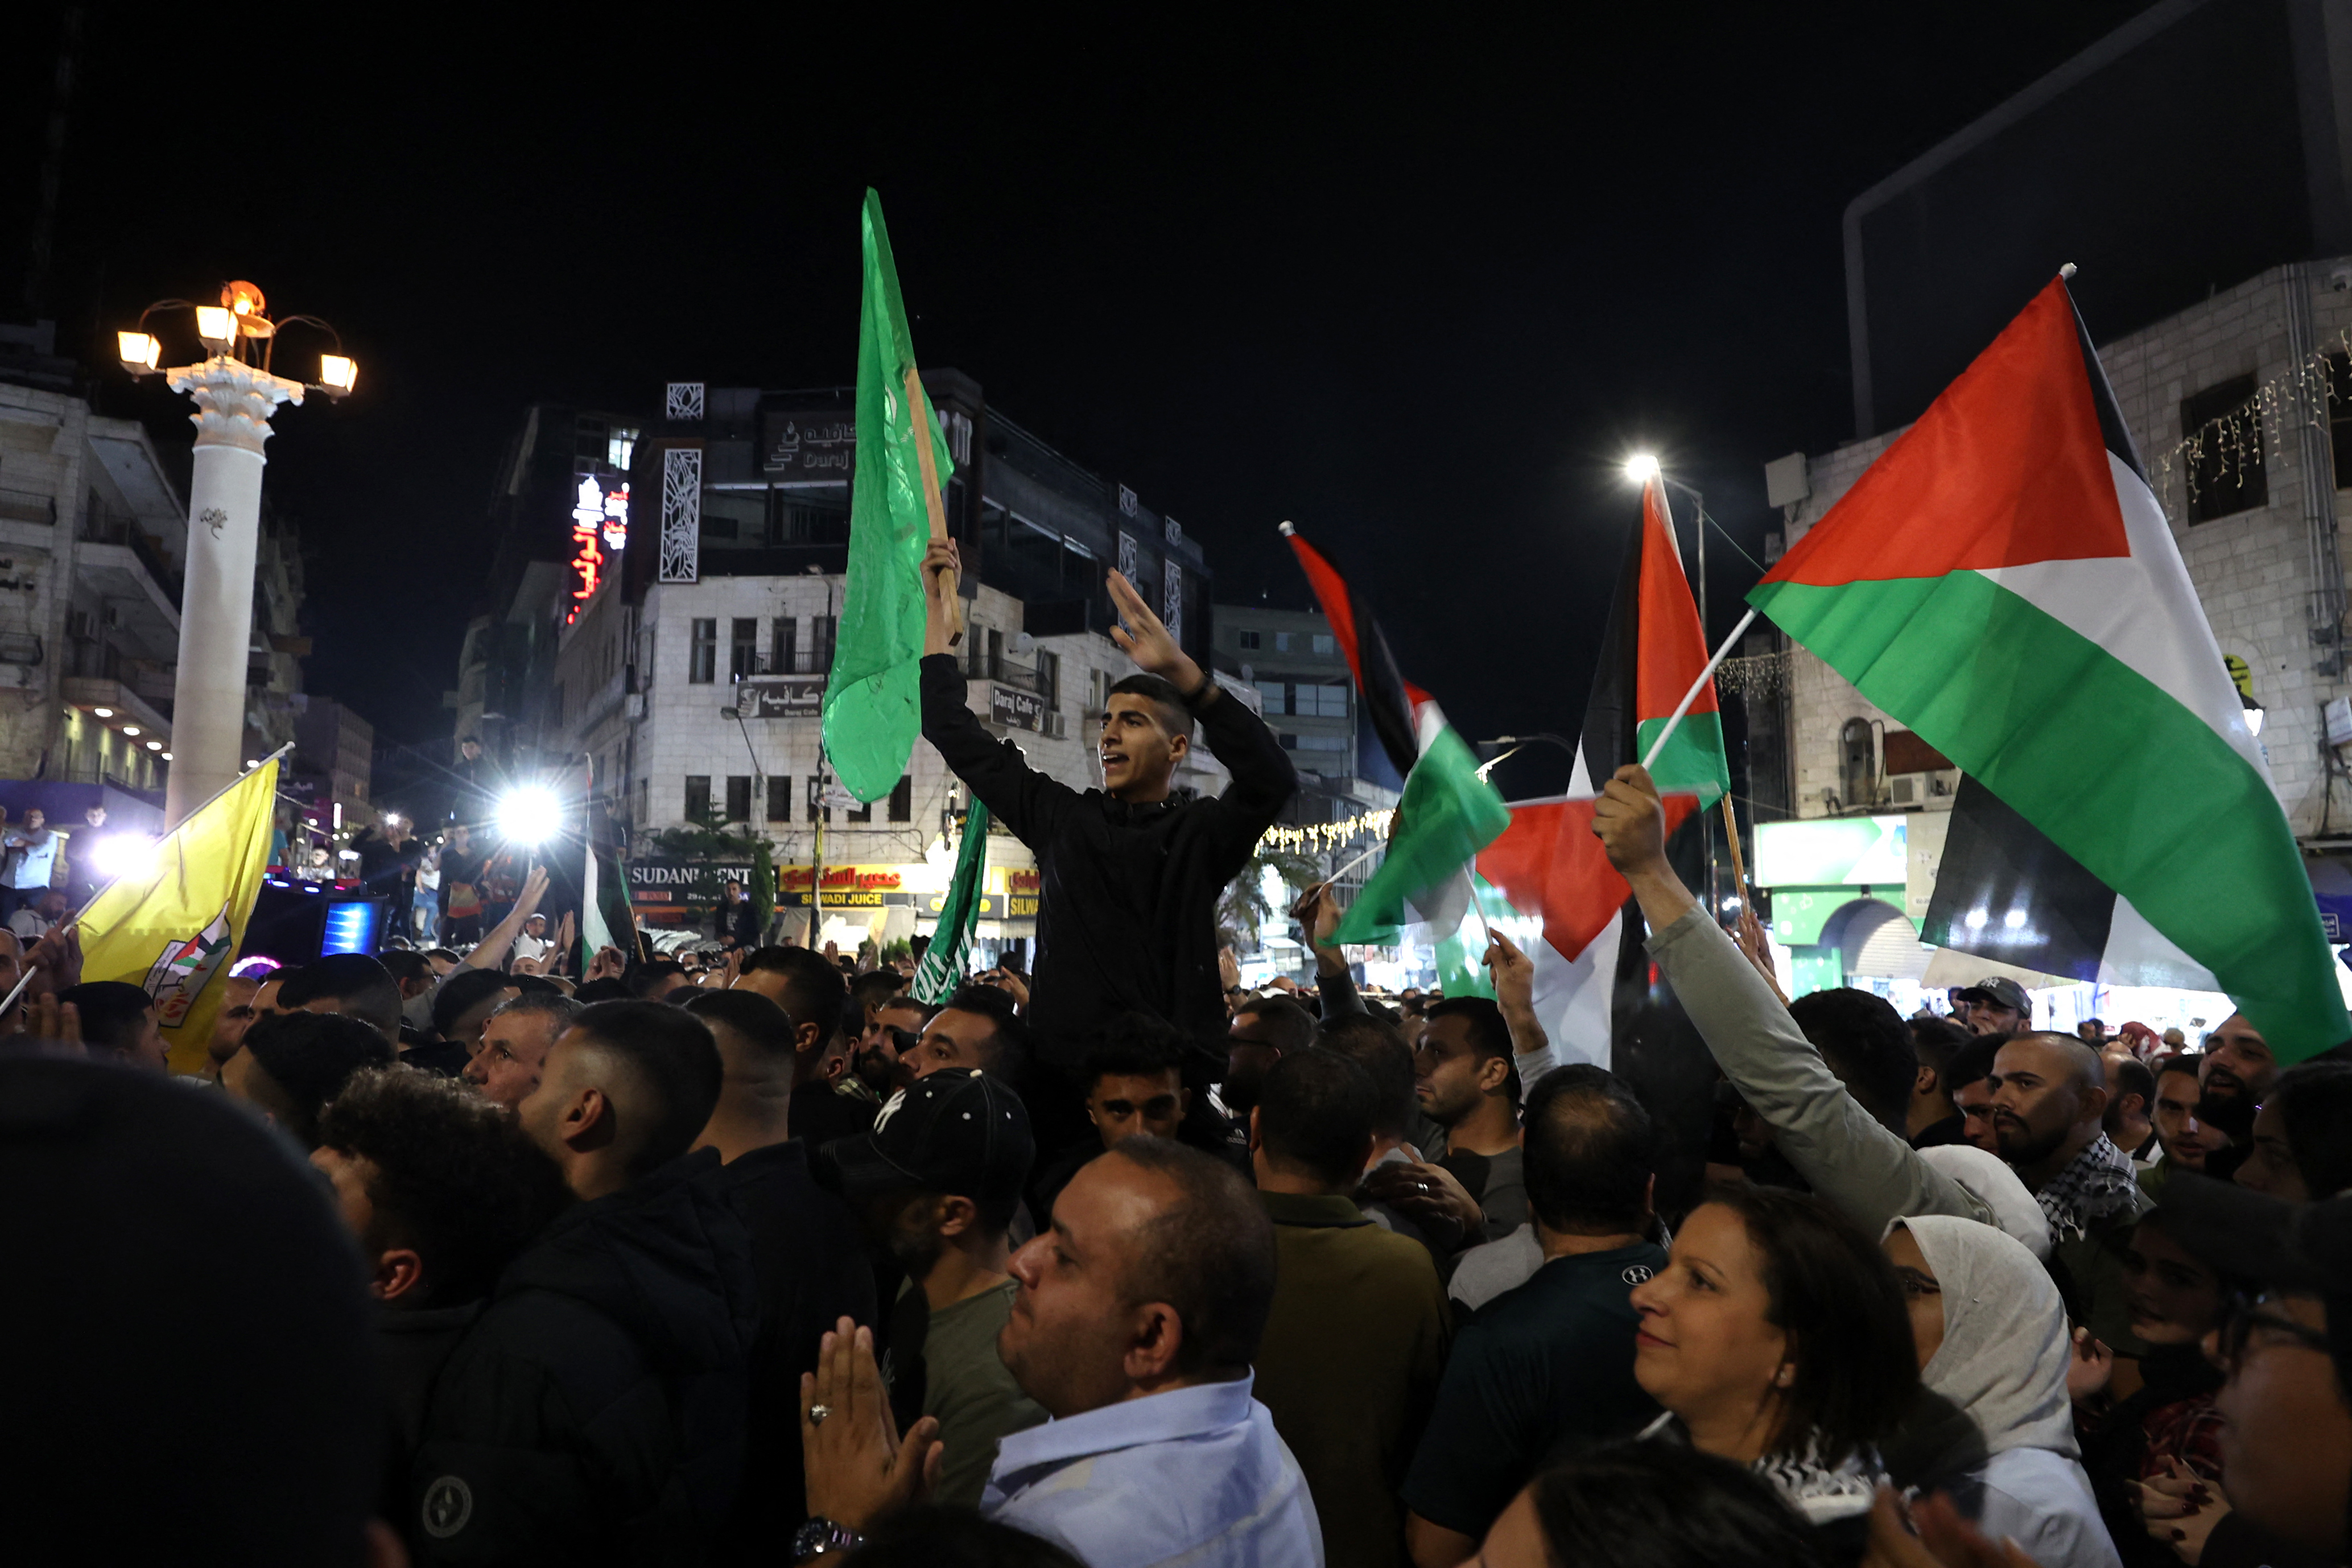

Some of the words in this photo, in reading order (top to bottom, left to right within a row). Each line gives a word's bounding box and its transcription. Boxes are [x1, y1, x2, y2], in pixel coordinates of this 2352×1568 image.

[762, 684, 819, 711] كافيه
[995, 689, 1015, 714] Daraj
[1016, 695, 1033, 715] Cafe
[858, 872, 901, 889] عصير
[801, 893, 846, 905] SIWADI
[848, 893, 882, 905] JUICE
